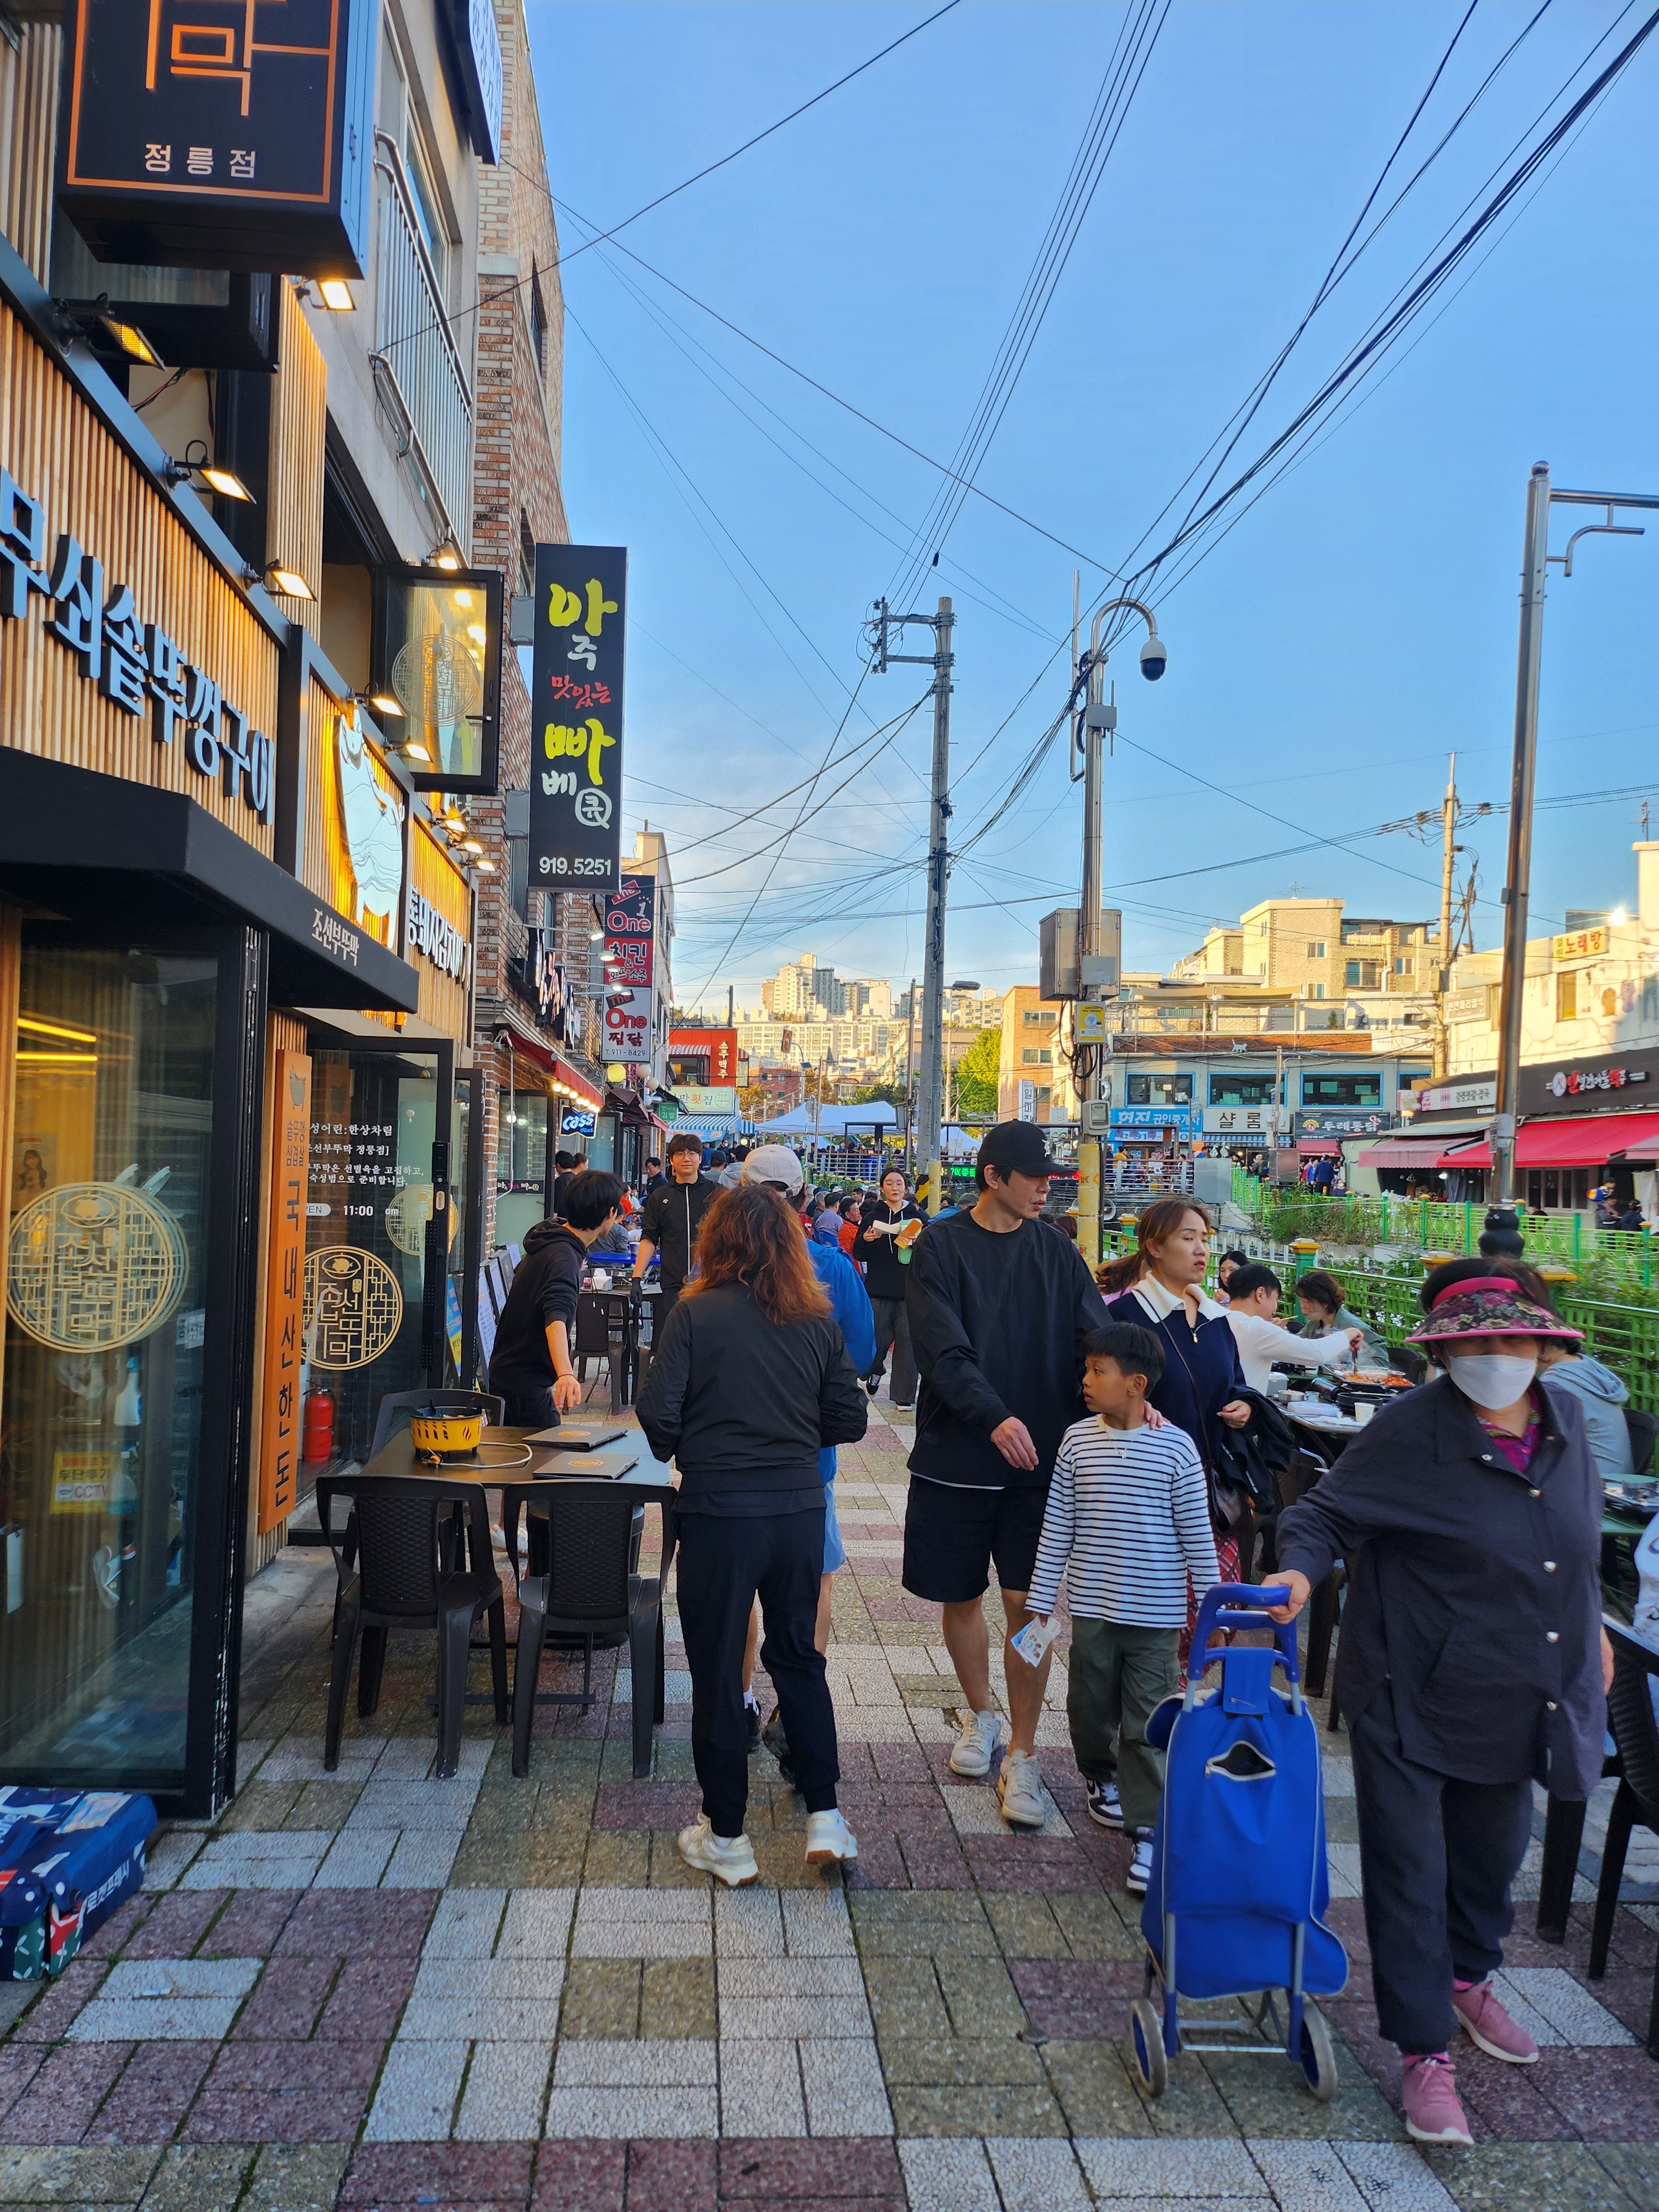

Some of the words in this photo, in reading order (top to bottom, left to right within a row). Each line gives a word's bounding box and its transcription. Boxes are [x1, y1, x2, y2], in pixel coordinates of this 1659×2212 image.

[144, 143, 257, 180] 정릉점
[549, 578, 618, 671] 아주
[0, 466, 275, 825] 무쇠솥뚜껑구이
[550, 674, 612, 709] 맛있는
[539, 857, 612, 876] 919.5251
[607, 911, 651, 932] One
[311, 908, 359, 967] 조선부뚜막
[1565, 931, 1601, 954] 노래방
[609, 942, 647, 966] 치킨
[625, 958, 633, 968] &
[608, 994, 631, 1006] The
[606, 1008, 647, 1029] One
[608, 1031, 643, 1047] 찜닭
[718, 1040, 729, 1079] 소주맥주
[677, 1093, 713, 1105] 만횟집
[286, 1120, 305, 1142] 솥뚜껑
[309, 1123, 393, 1137] 성어린:한상차림
[1219, 1112, 1261, 1129] 샬롬
[1322, 1120, 1380, 1132] 두레통닭
[286, 1145, 305, 1167] 삼겹살
[309, 1176, 356, 1184] 숙성법으로
[359, 1176, 408, 1187] 준비합니다.
[384, 1166, 424, 1176] 고집하고,
[343, 1206, 373, 1216] 11:00
